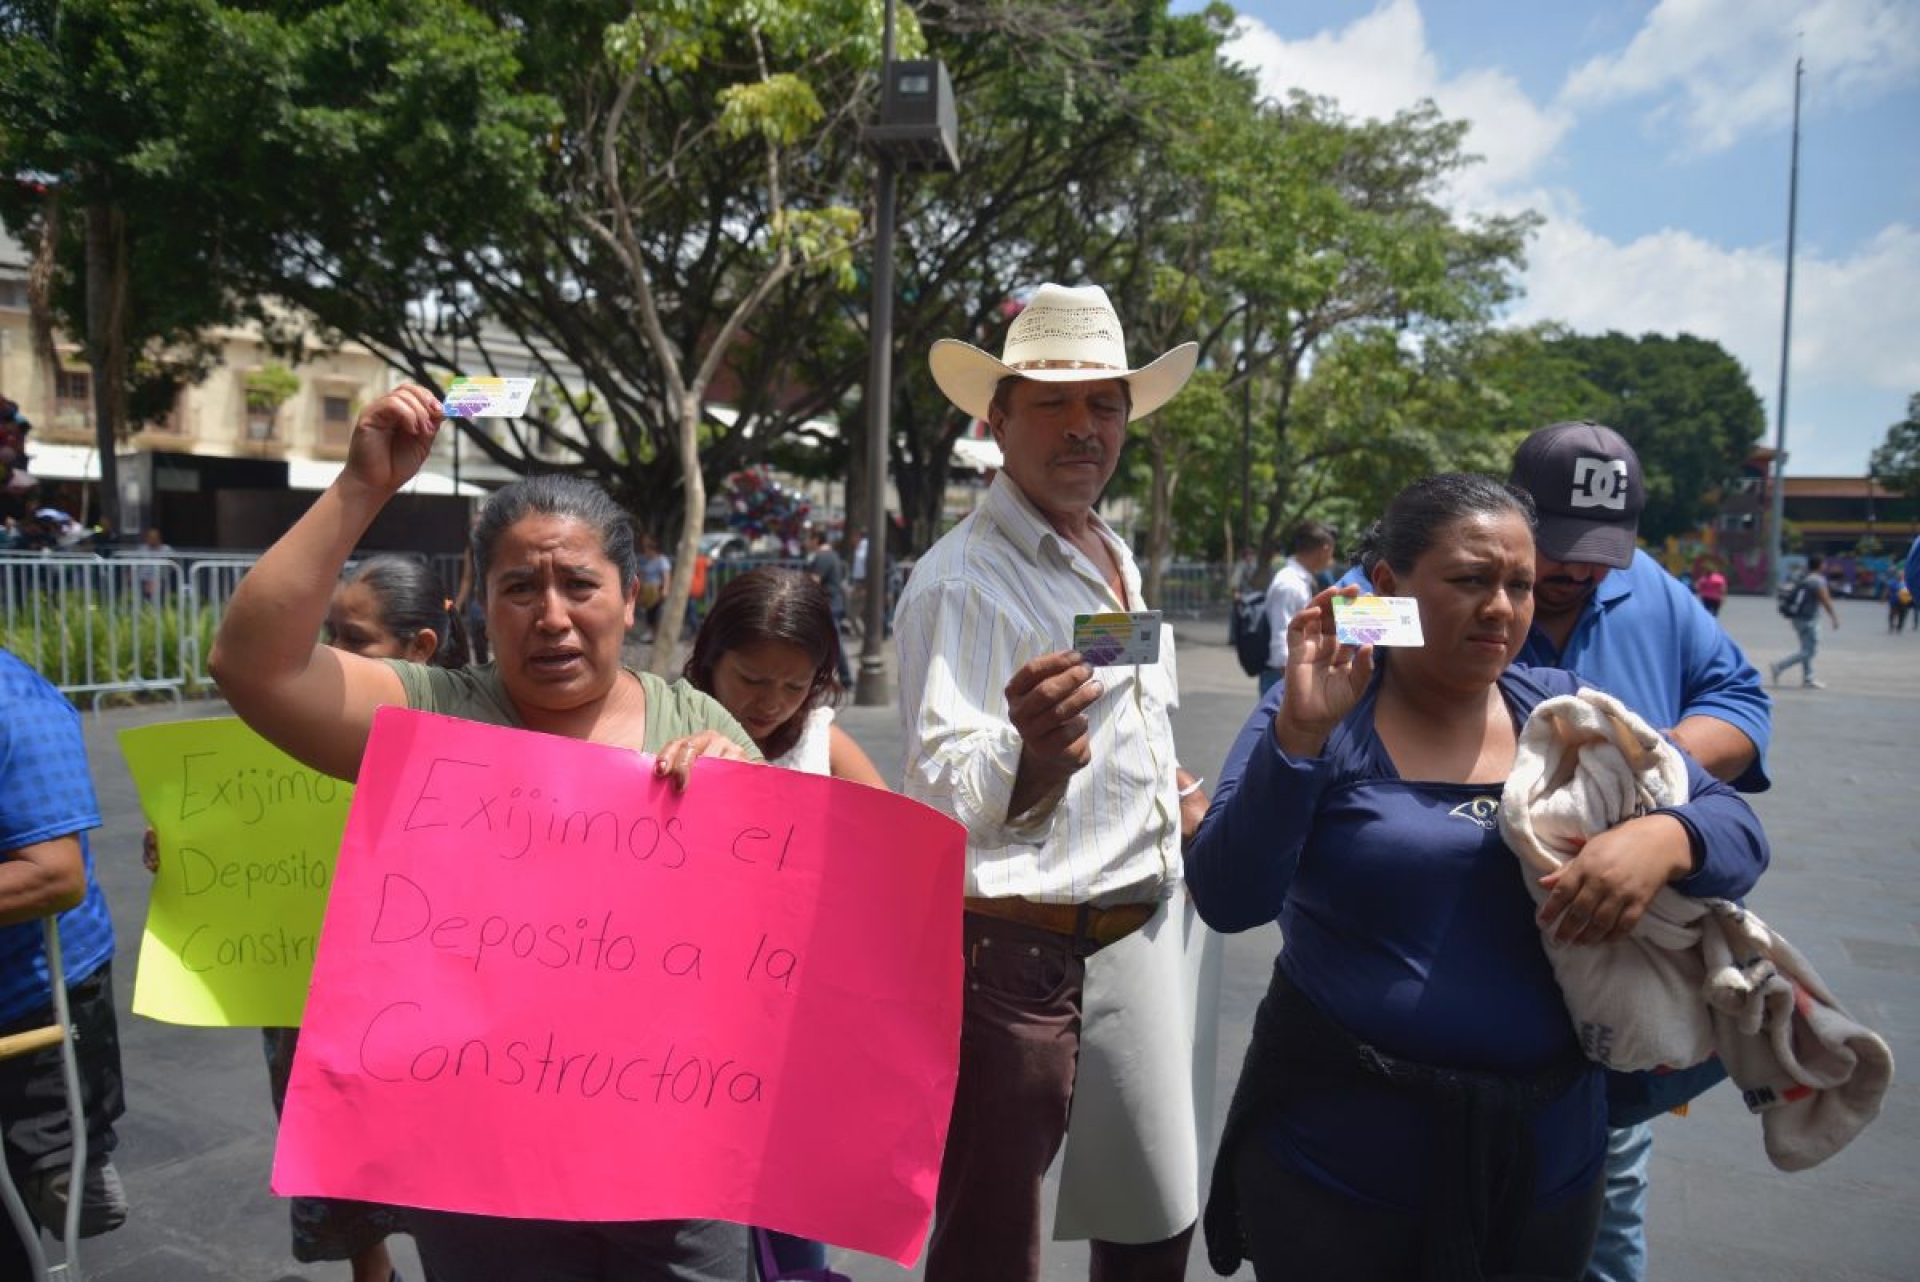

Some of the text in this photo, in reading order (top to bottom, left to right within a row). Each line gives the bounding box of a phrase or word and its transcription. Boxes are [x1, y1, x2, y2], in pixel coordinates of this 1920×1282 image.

[1571, 457, 1628, 510] DC
[181, 751, 351, 825] Exijimo
[404, 758, 795, 871] Exijimos el
[180, 847, 327, 899] Deposito
[371, 872, 798, 989] Deposito a la
[359, 1001, 762, 1108] Constructora
